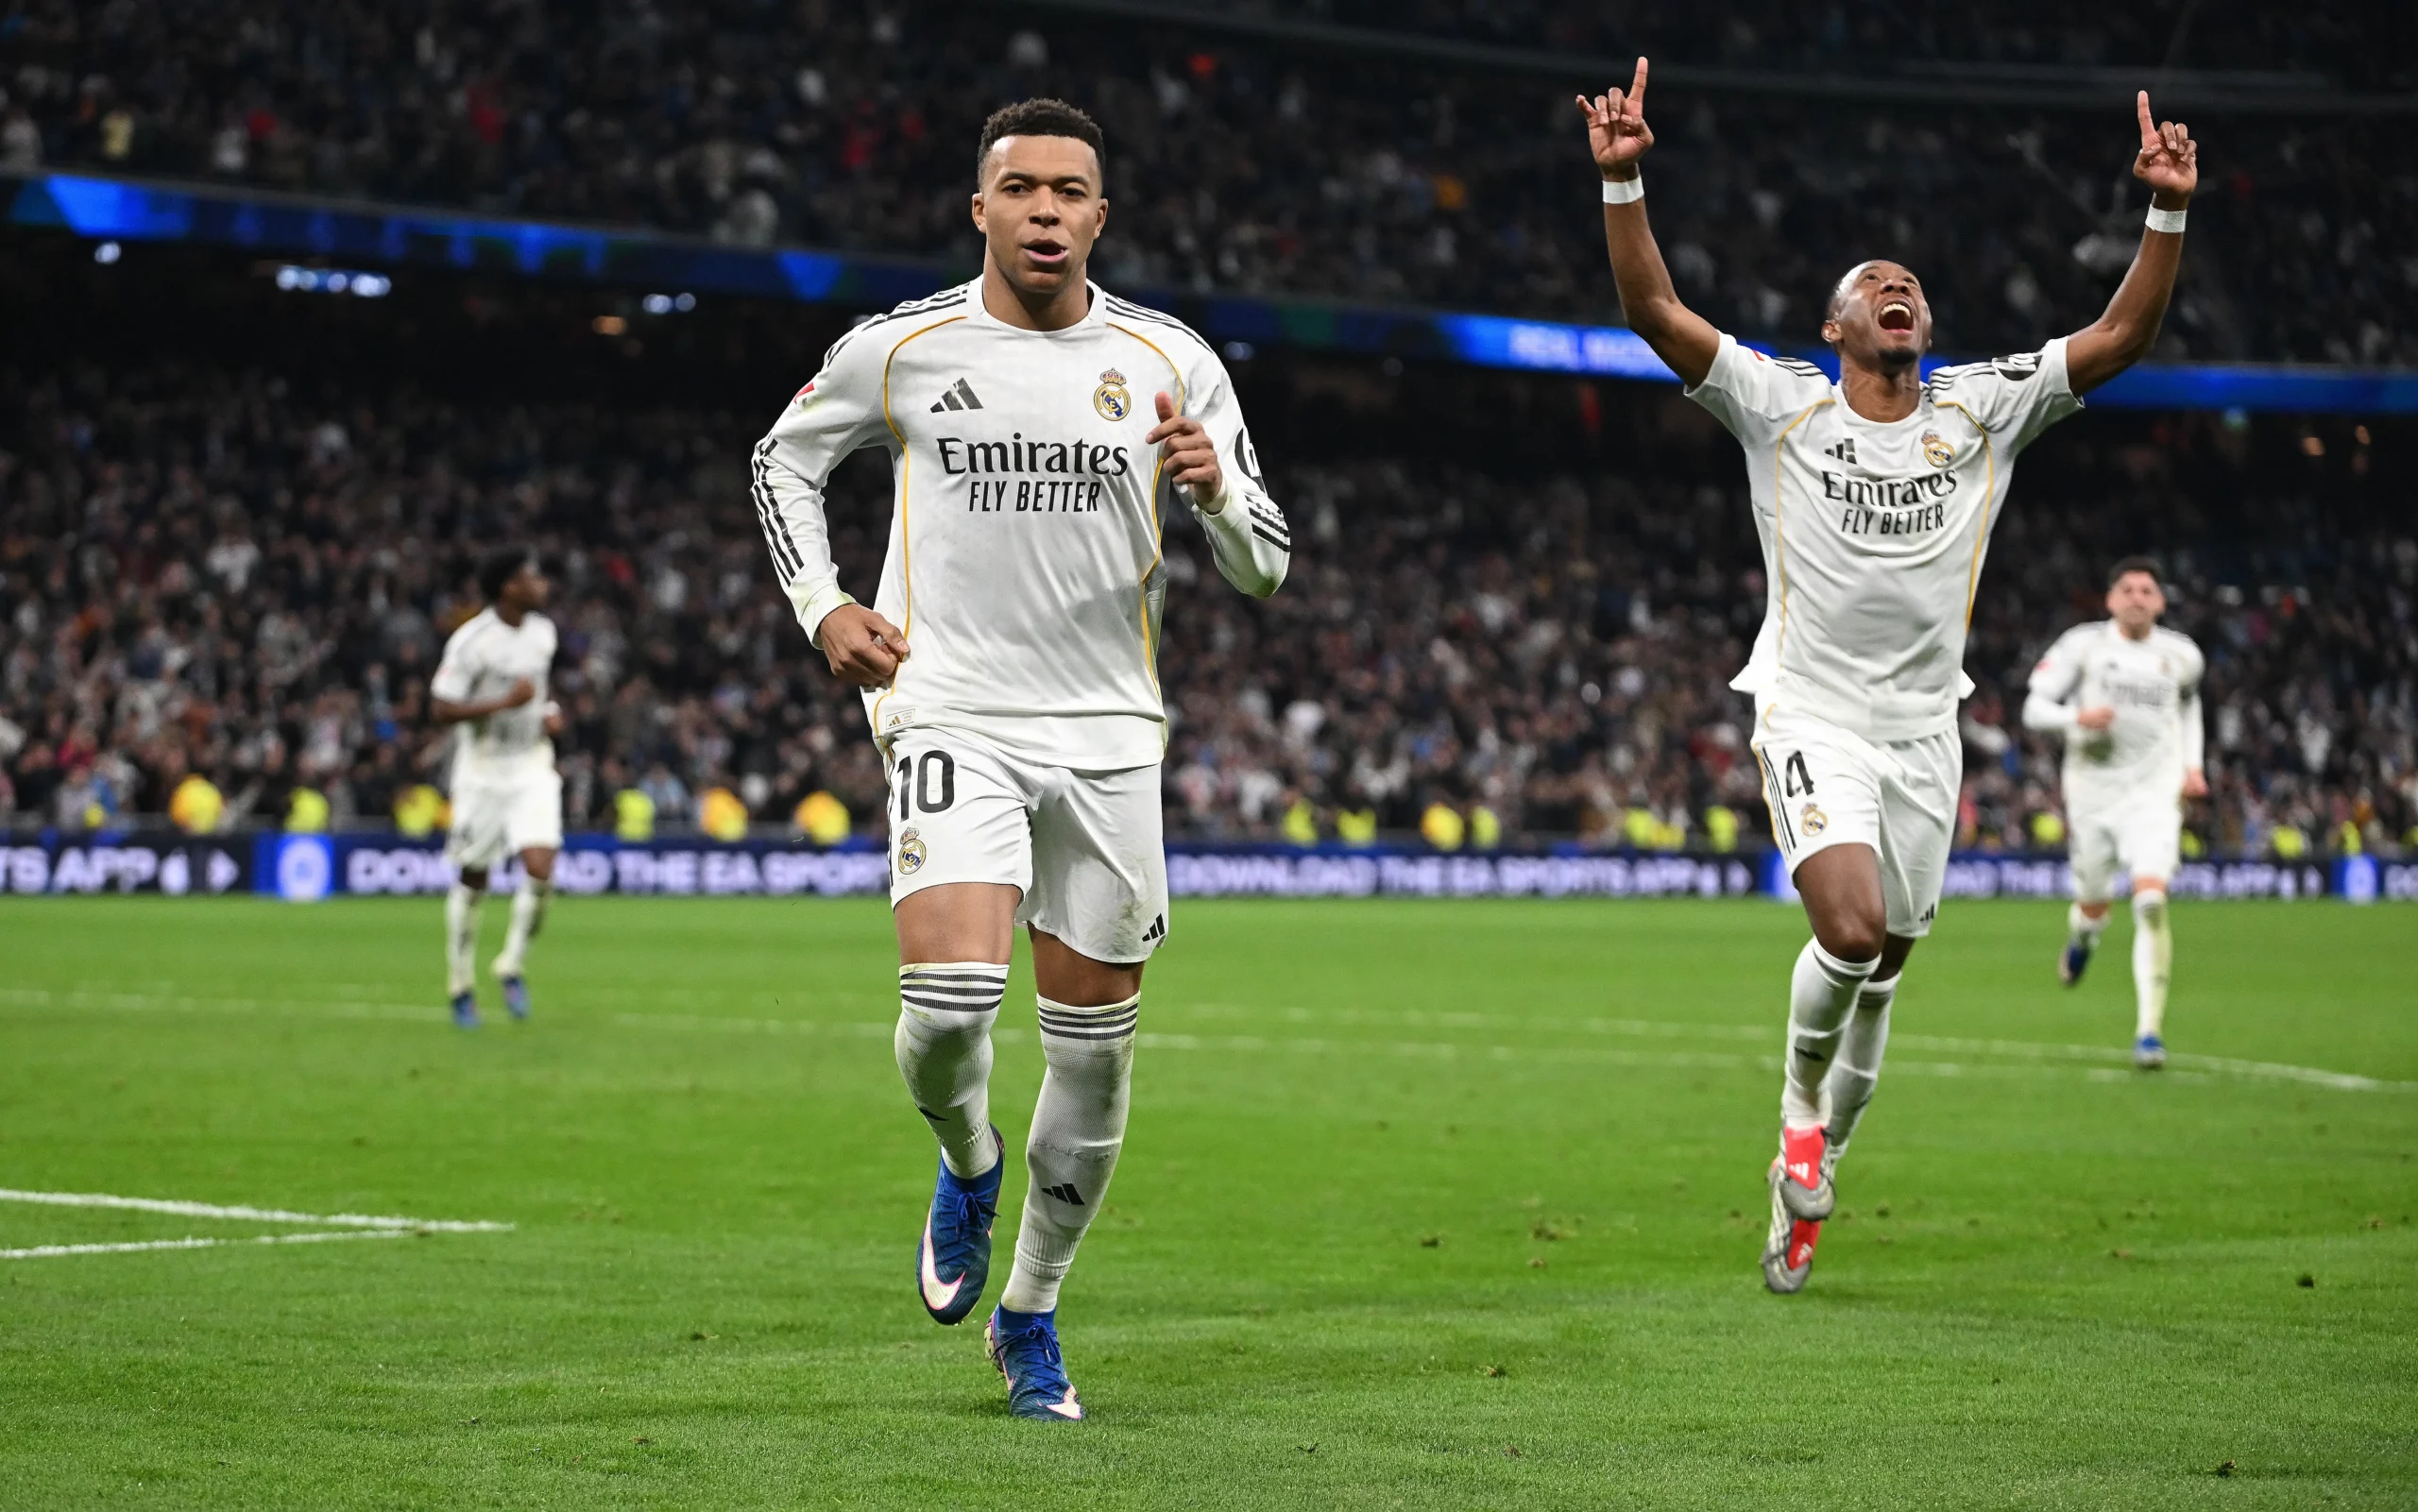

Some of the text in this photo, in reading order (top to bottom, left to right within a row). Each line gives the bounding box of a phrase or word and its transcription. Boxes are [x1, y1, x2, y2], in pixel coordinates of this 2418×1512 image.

[936, 432, 1129, 476] Emirates
[968, 481, 1100, 512] FLY BETTER
[1821, 468, 1957, 507] Emirates
[1841, 503, 1945, 535] FLY BETTER
[896, 750, 954, 823] 10
[1785, 750, 1814, 798] 4
[53, 847, 159, 895] APP
[347, 848, 891, 895] DOWLAD THE EA SPORT
[1167, 854, 1376, 896] DOWNLOAD
[1380, 855, 1441, 896] THE
[1496, 856, 1630, 897] SPORTS
[1634, 858, 1699, 895] APP
